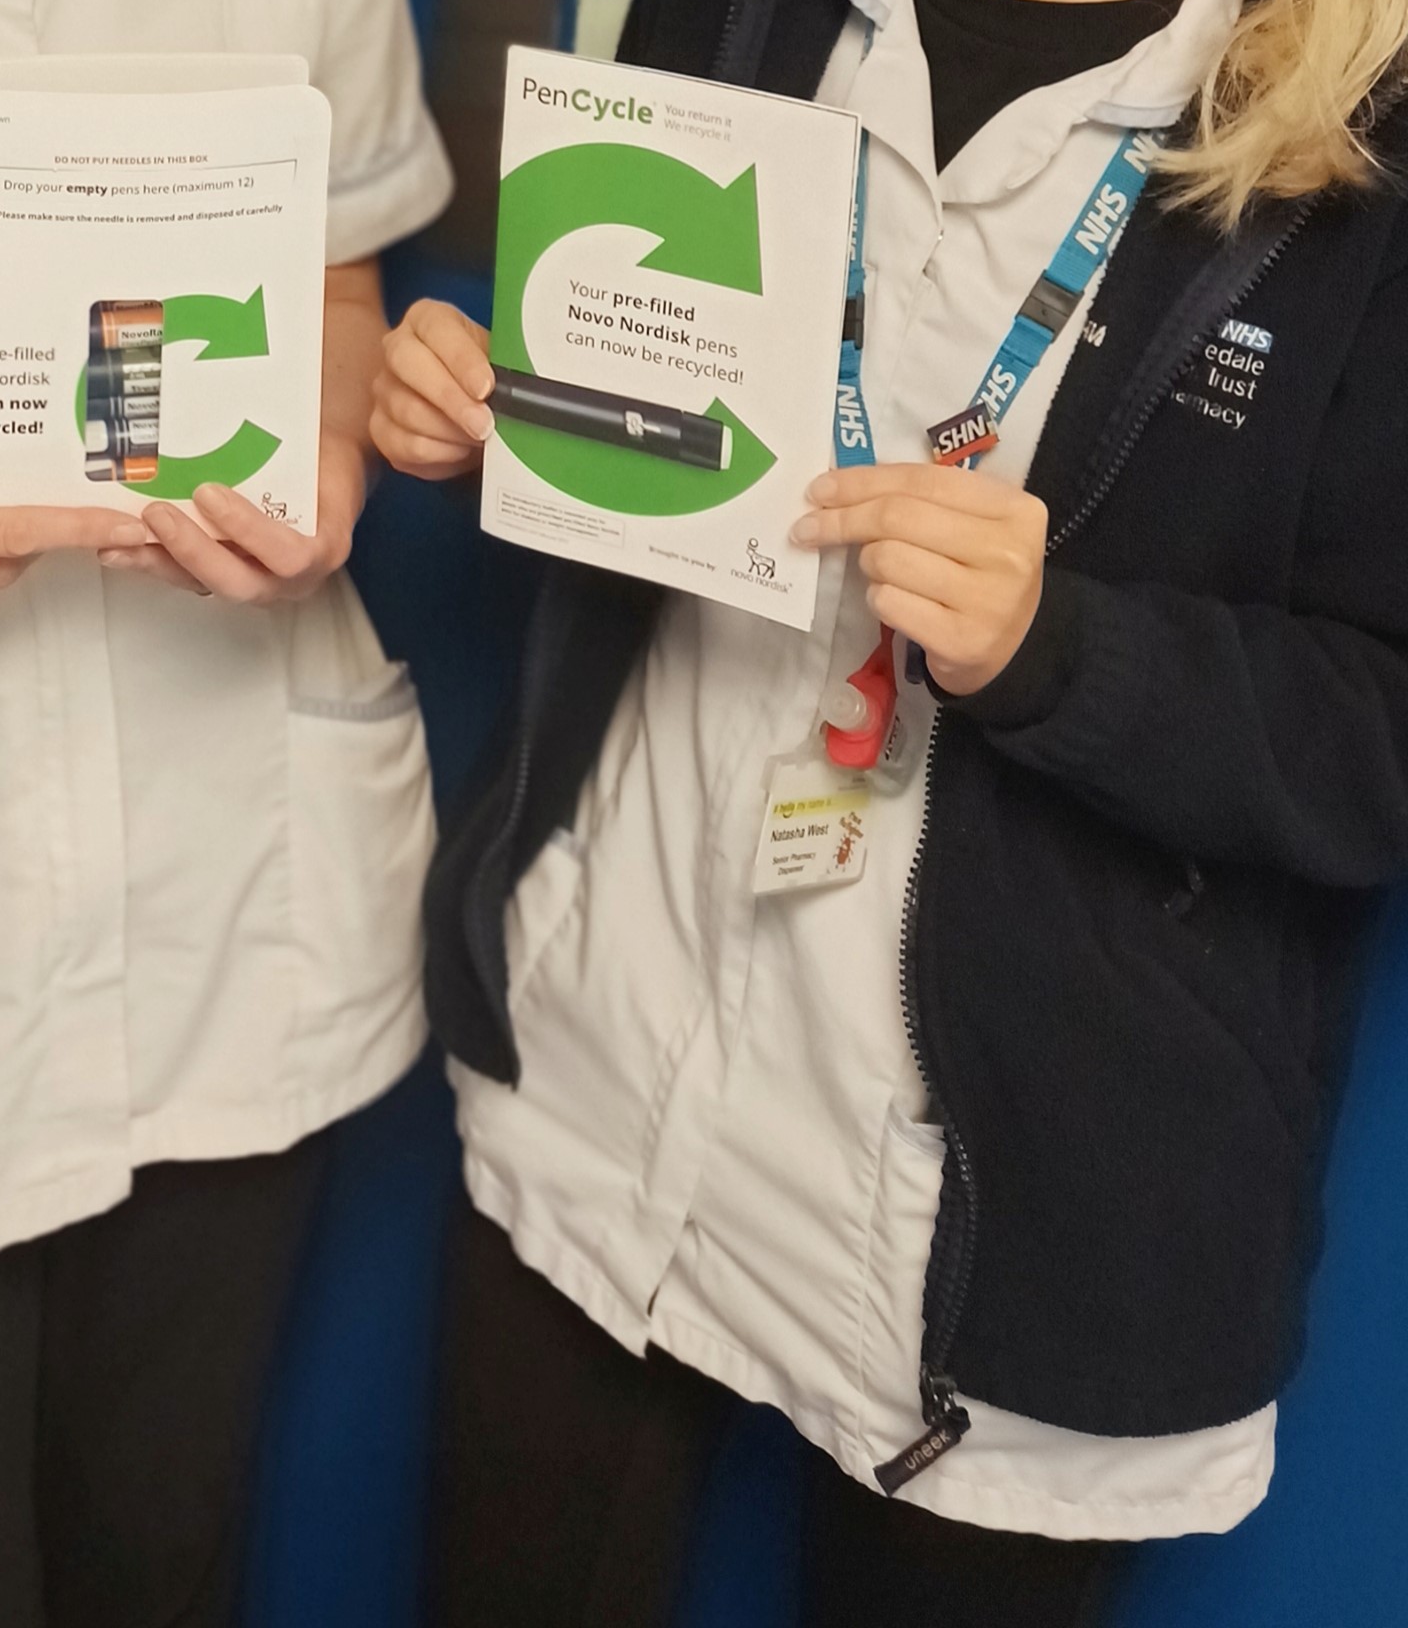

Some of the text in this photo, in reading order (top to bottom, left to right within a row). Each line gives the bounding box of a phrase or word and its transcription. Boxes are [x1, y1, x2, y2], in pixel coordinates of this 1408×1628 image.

[522, 77, 653, 125] PenCycle
[665, 103, 686, 118] You
[688, 110, 723, 125] return
[684, 124, 722, 140] recycle
[54, 155, 209, 165] DO NOT PUT NEEDLES IN THIS BOX
[3, 176, 255, 197] Drop your empty pens here (maximum 12)
[28, 212, 53, 221] make
[55, 214, 74, 222] sure
[76, 214, 92, 223] the
[93, 214, 124, 223] needle
[136, 213, 175, 223] removed
[177, 212, 194, 221] and
[195, 209, 234, 221] disposed
[235, 207, 245, 217] of
[245, 204, 283, 216] carefully
[1074, 182, 1128, 256] NHS
[569, 279, 696, 322] Your pre-filled
[568, 304, 738, 359] Novo Nordisk pens
[1220, 319, 1273, 350] NHS
[565, 331, 744, 386] can now be recycled!
[1204, 343, 1265, 376] edale
[9, 398, 48, 411] now
[836, 383, 868, 449] NHS
[730, 568, 789, 594] novo nordisk
[904, 1429, 952, 1471] uneek
